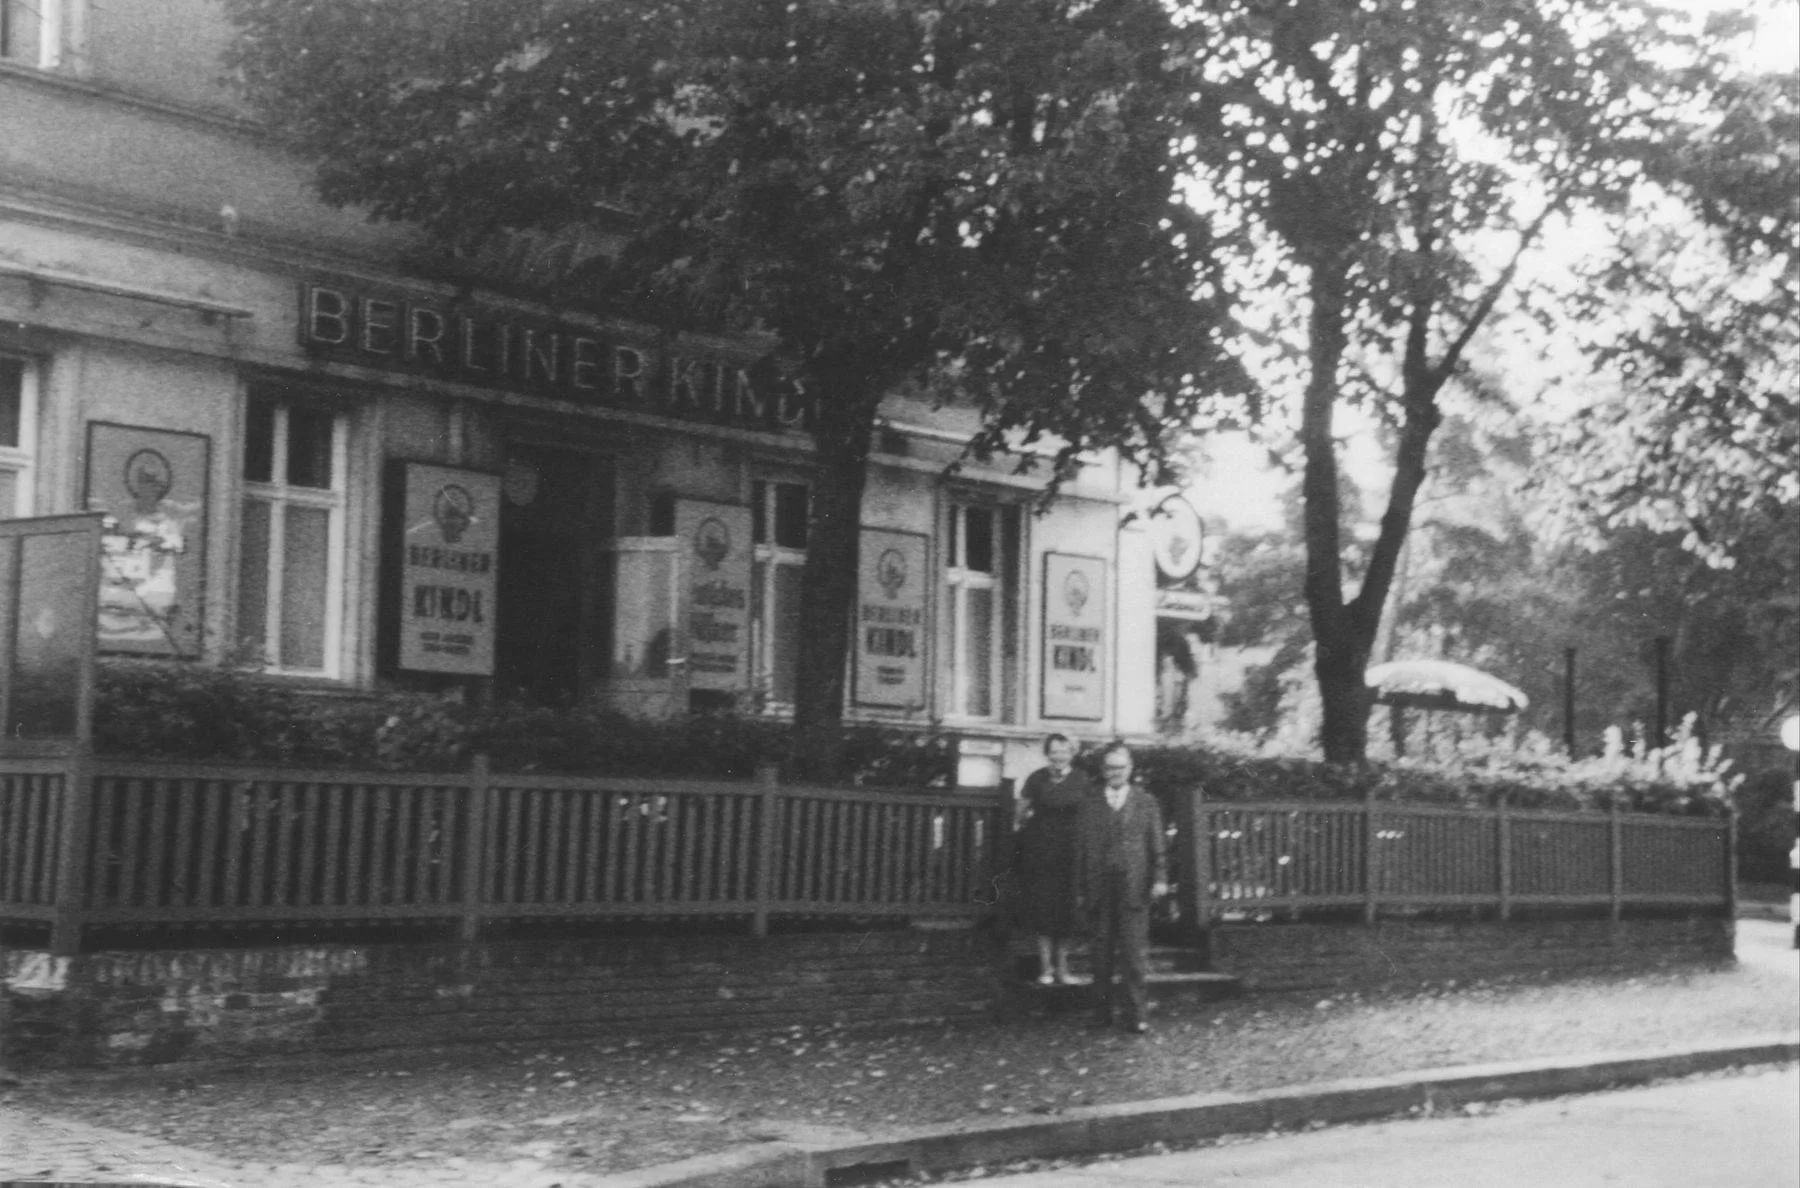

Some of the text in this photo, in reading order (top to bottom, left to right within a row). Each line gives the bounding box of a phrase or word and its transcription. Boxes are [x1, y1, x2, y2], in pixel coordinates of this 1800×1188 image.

[309, 286, 822, 425] BERLINER KIND
[414, 585, 482, 622] KINDL
[867, 628, 915, 658] KINDL
[1053, 645, 1095, 671] KINDL
